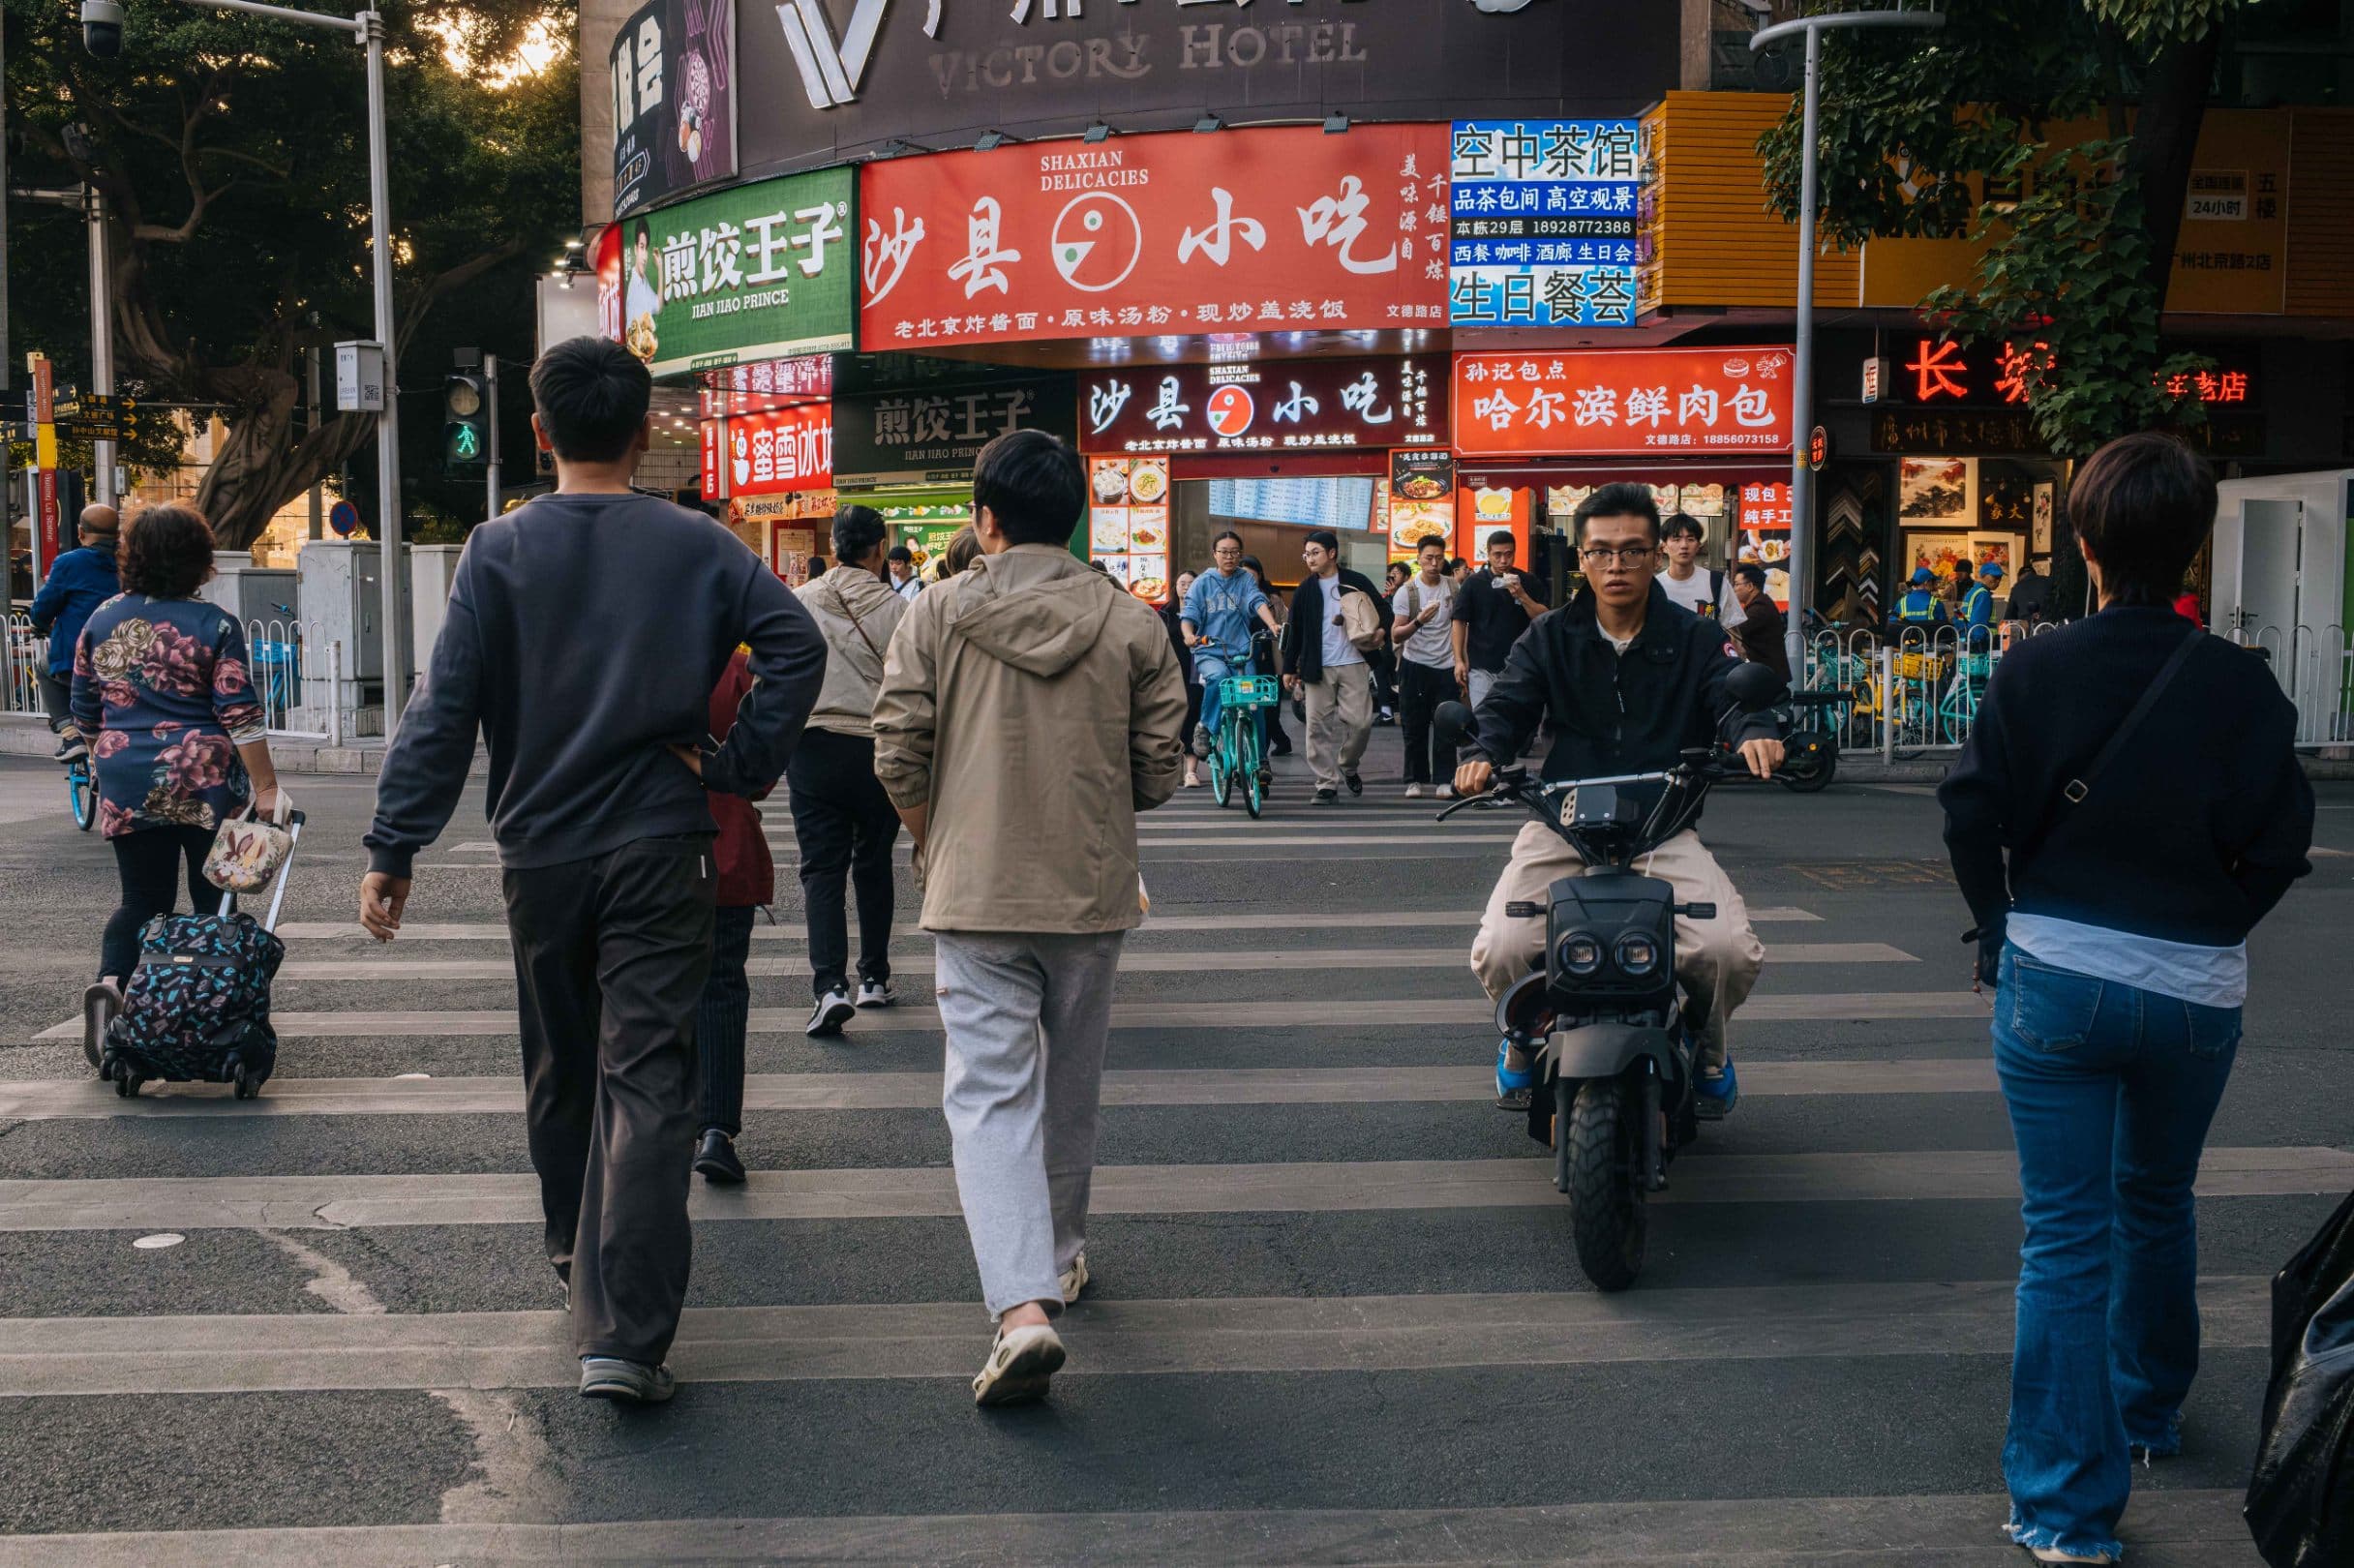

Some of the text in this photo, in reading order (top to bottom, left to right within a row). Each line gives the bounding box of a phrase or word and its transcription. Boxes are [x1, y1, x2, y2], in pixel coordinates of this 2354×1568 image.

[928, 33, 1152, 100] VICTORY
[1178, 22, 1368, 69] HOTEL
[1041, 150, 1123, 171] SHAXIAN
[1454, 125, 1636, 178] 空中茶馆
[1041, 168, 1149, 191] DELICACIES
[1400, 154, 1420, 260] 美味源自
[1455, 186, 1635, 212] 品茶包间 高空观景
[2192, 201, 2241, 216] 24小时
[1456, 221, 1632, 234] 本栋29层 18928772388
[663, 201, 843, 303] 煎饺王子
[1455, 243, 1634, 262] 西餐 咖啡 酒廊 生日会
[692, 289, 789, 319] JIAN JIAO PRINCE
[1453, 271, 1632, 322] 生日餐荟
[1387, 305, 1442, 318] 文德路店
[1209, 365, 1249, 376] SHAXIAN
[1209, 374, 1260, 385] DELICACIES
[1465, 359, 1567, 382] 孙记包点
[874, 389, 1032, 445] 煎饺王子
[1473, 383, 1777, 431] 哈尔滨鲜肉包
[1704, 434, 1779, 444] 18856073158
[951, 446, 981, 458] PRINC
[1744, 487, 1776, 501] 现包
[1743, 509, 1793, 524] 纯手工
